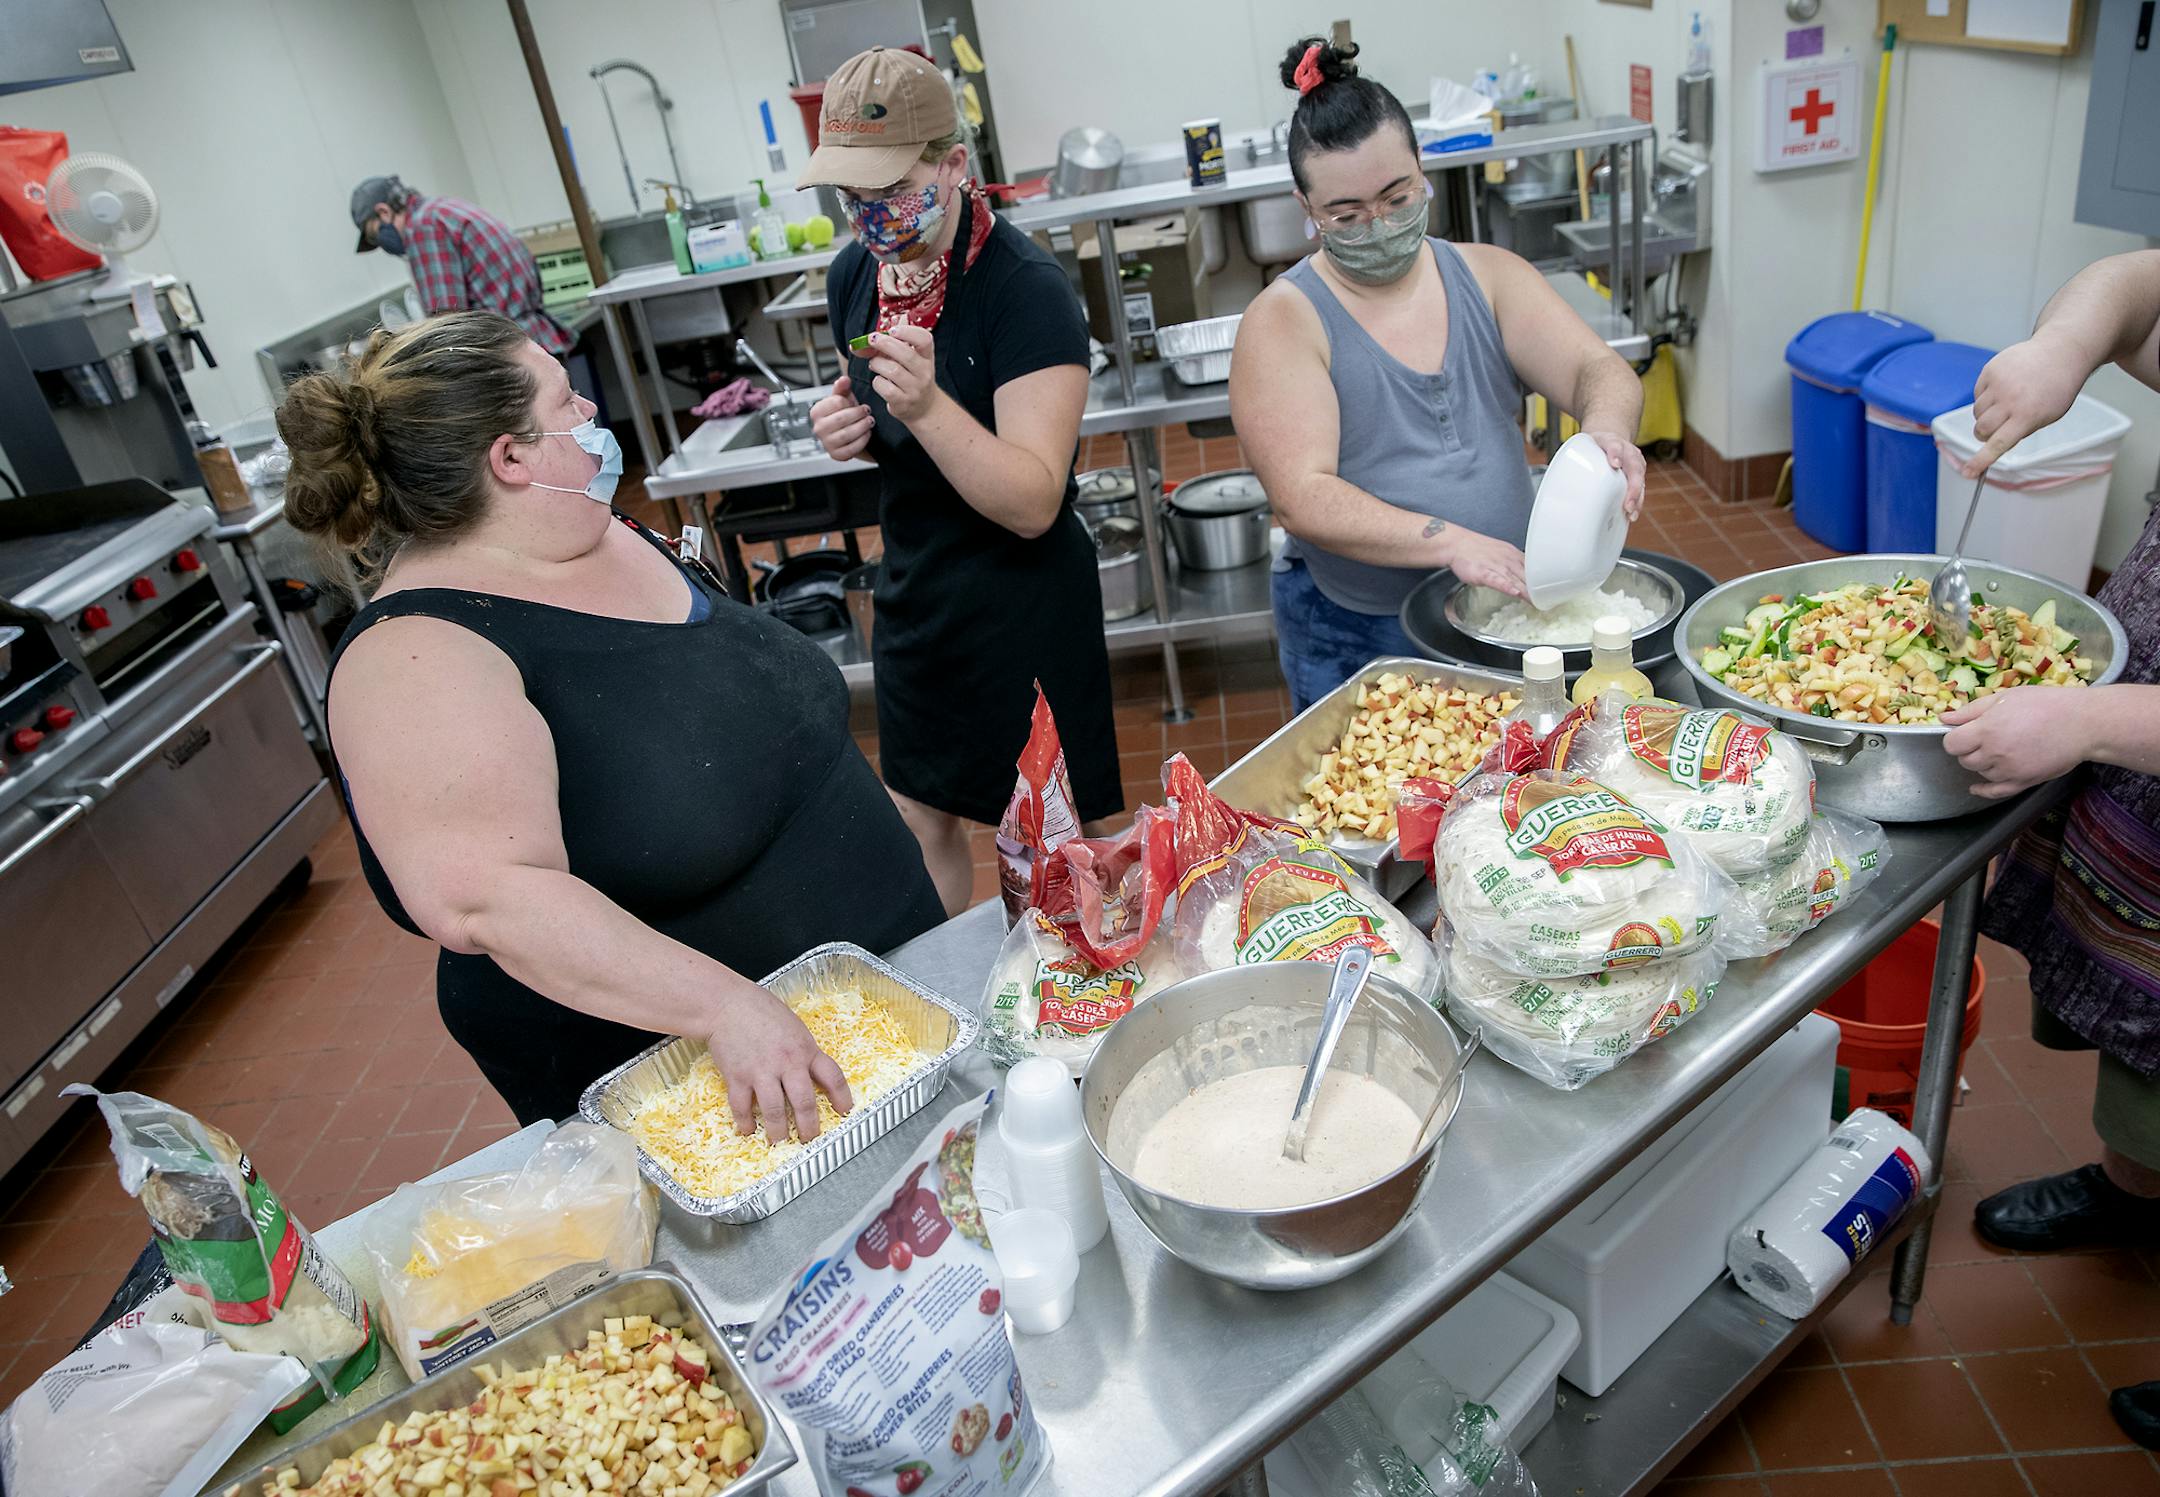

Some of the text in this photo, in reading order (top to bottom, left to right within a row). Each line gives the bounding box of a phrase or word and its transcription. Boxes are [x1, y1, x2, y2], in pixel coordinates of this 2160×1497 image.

[1783, 138, 1840, 157] FIRST AID
[1580, 839, 1638, 858] CASERAS
[1602, 833, 1616, 844] DE
[1616, 830, 1655, 845] HARINA
[1481, 868, 1508, 892] 2/15
[1530, 867, 1547, 880] SEP
[1245, 896, 1364, 964] GUERRERO
[1530, 923, 1581, 942] CASERAS
[1605, 947, 1661, 959] GUERRERO
[995, 996, 1017, 1008] 2/15
[1524, 986, 1551, 1012] 2/15
[754, 1260, 853, 1363] CRAISINS
[775, 1344, 800, 1373] DRIED
[800, 1291, 852, 1346] CRANBERRIES
[825, 1340, 857, 1371] DRIED
[856, 1283, 905, 1342] CRANBERRIES
[467, 1339, 488, 1354] JACK
[834, 1347, 867, 1379] SALAD
[872, 1407, 897, 1438] DRIED
[895, 1348, 953, 1411] CRANBERRIES
[875, 1412, 906, 1449] POWER
[906, 1387, 932, 1417] BITES
